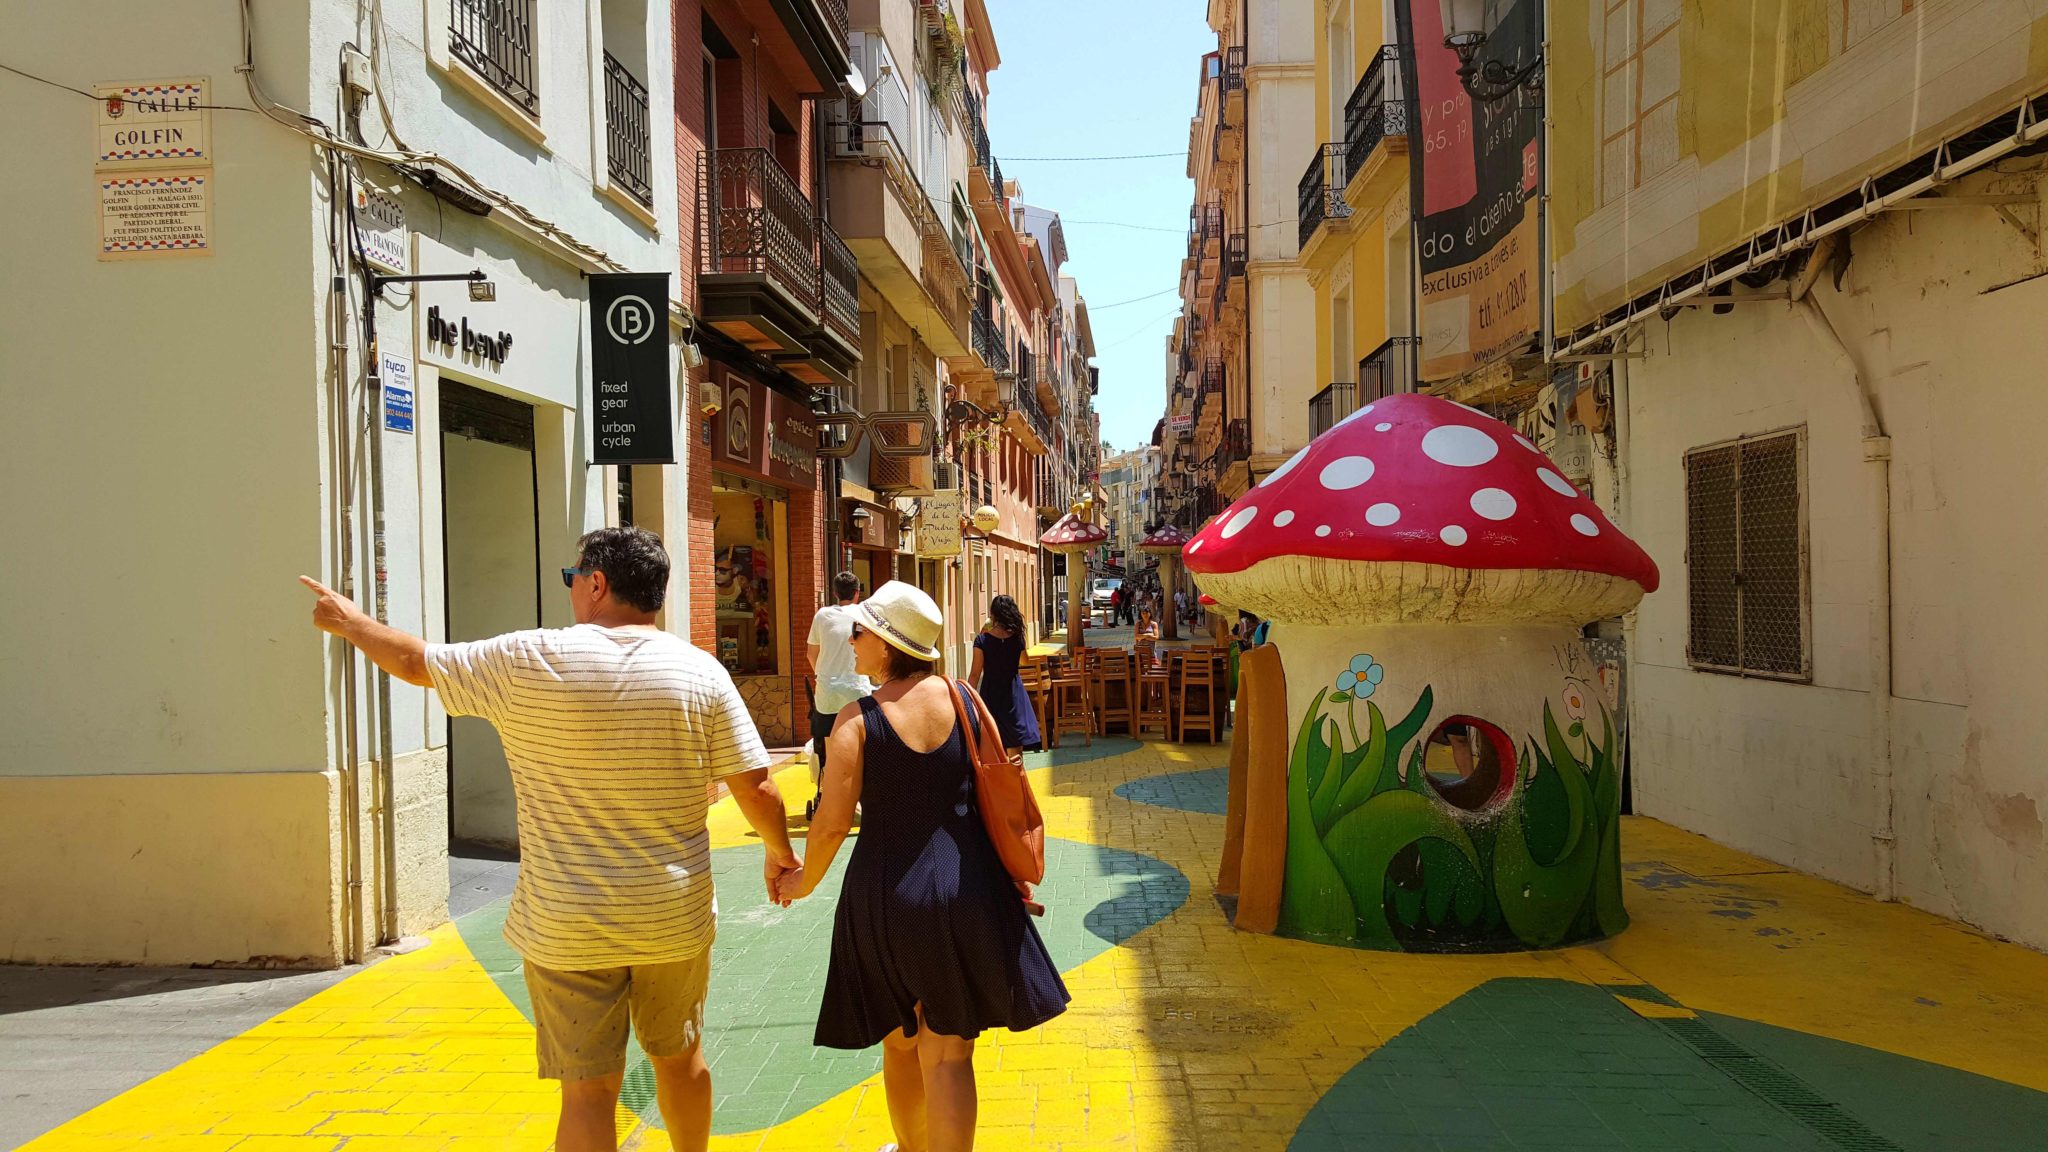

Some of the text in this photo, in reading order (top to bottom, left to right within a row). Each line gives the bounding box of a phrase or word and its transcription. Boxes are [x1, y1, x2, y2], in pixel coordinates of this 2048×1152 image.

[137, 96, 199, 114] CALLE
[115, 128, 183, 146] GOLFIN
[133, 203, 181, 211] GOBERNADOR
[123, 219, 154, 227] PARTIDO
[371, 203, 401, 229] CALLE
[1424, 232, 1455, 258] do
[1465, 217, 1477, 246] el
[373, 233, 404, 259] FRANCISCO
[1422, 265, 1483, 297] exclusiva
[1484, 261, 1490, 277] a
[428, 305, 458, 347] the
[385, 358, 406, 373] tyco
[601, 381, 628, 393] fixed
[601, 399, 628, 411] gear
[602, 421, 636, 433] urban
[602, 435, 632, 449] cycle
[931, 512, 940, 520] de
